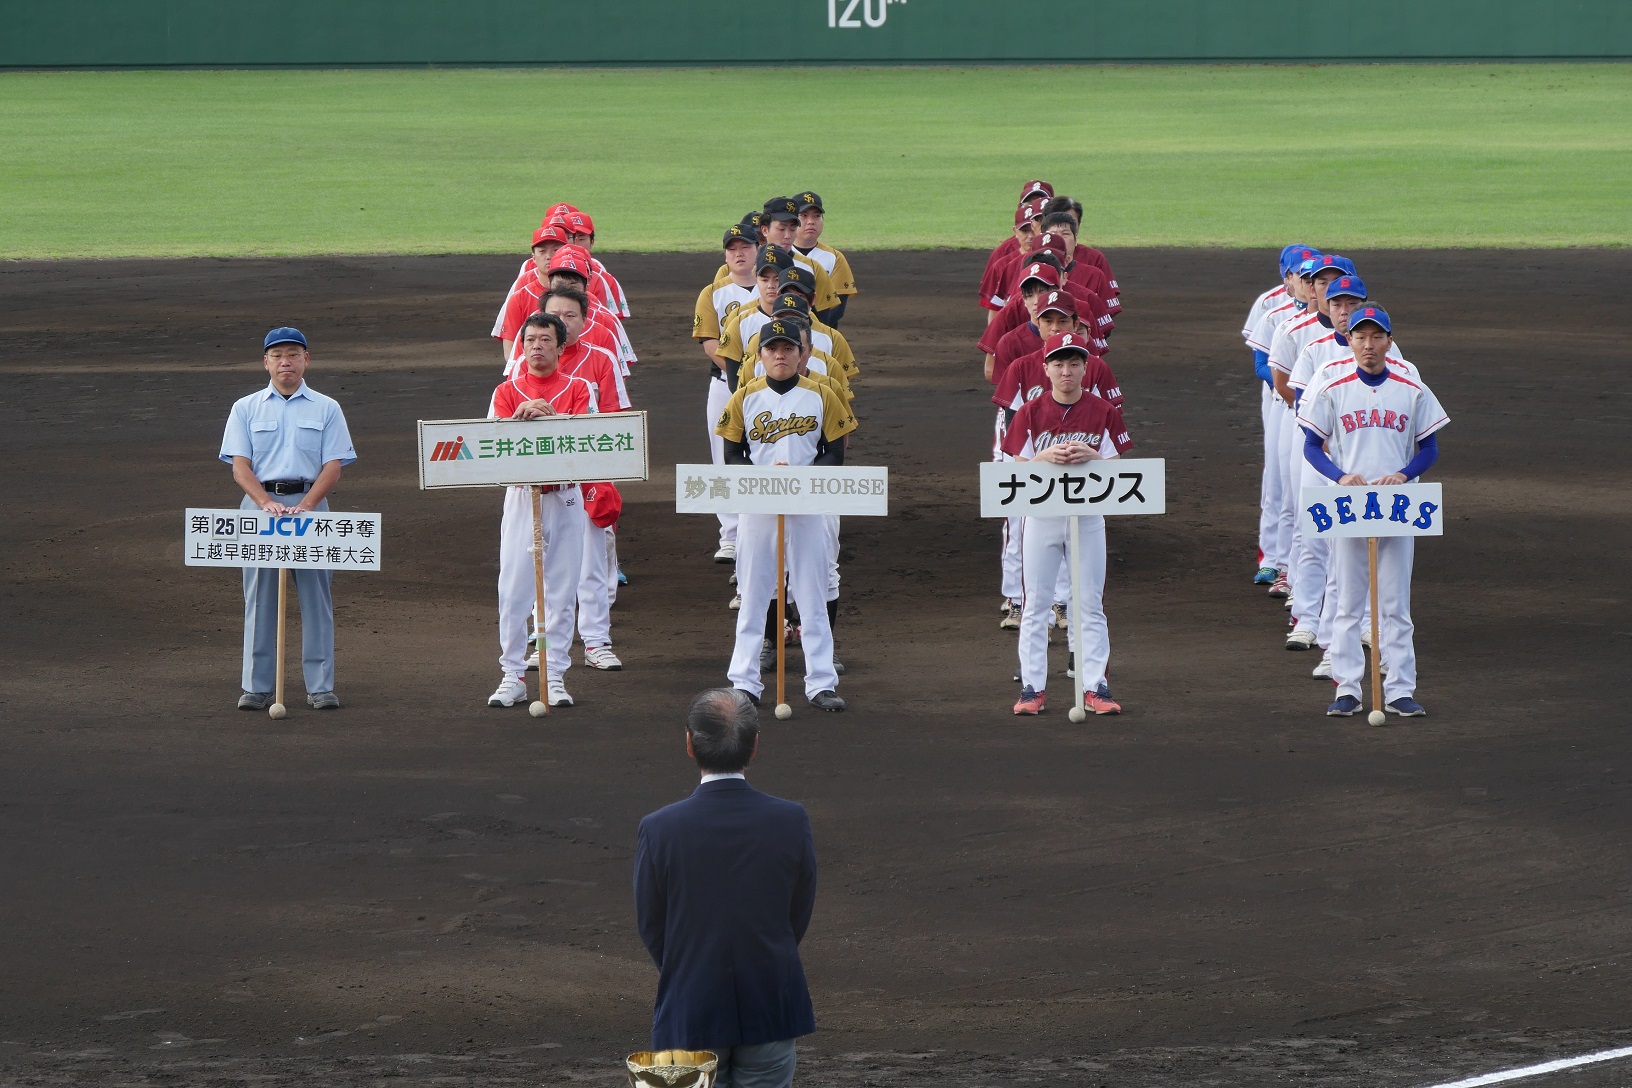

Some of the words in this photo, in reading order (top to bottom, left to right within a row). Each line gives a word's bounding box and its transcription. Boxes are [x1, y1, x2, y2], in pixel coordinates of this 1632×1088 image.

[827, 0, 908, 28] 120
[1340, 278, 1351, 289] B
[749, 410, 819, 444] Spring
[1340, 408, 1409, 434] BEARS
[478, 432, 635, 459] 三井企画株式会社
[684, 475, 732, 500] 妙高
[737, 477, 802, 496] SPRING
[809, 477, 885, 496] HORSE
[998, 472, 1146, 506] ナンセンス
[1307, 491, 1439, 533] BEARS
[190, 541, 376, 565] 上越早朝野球選手権大会
